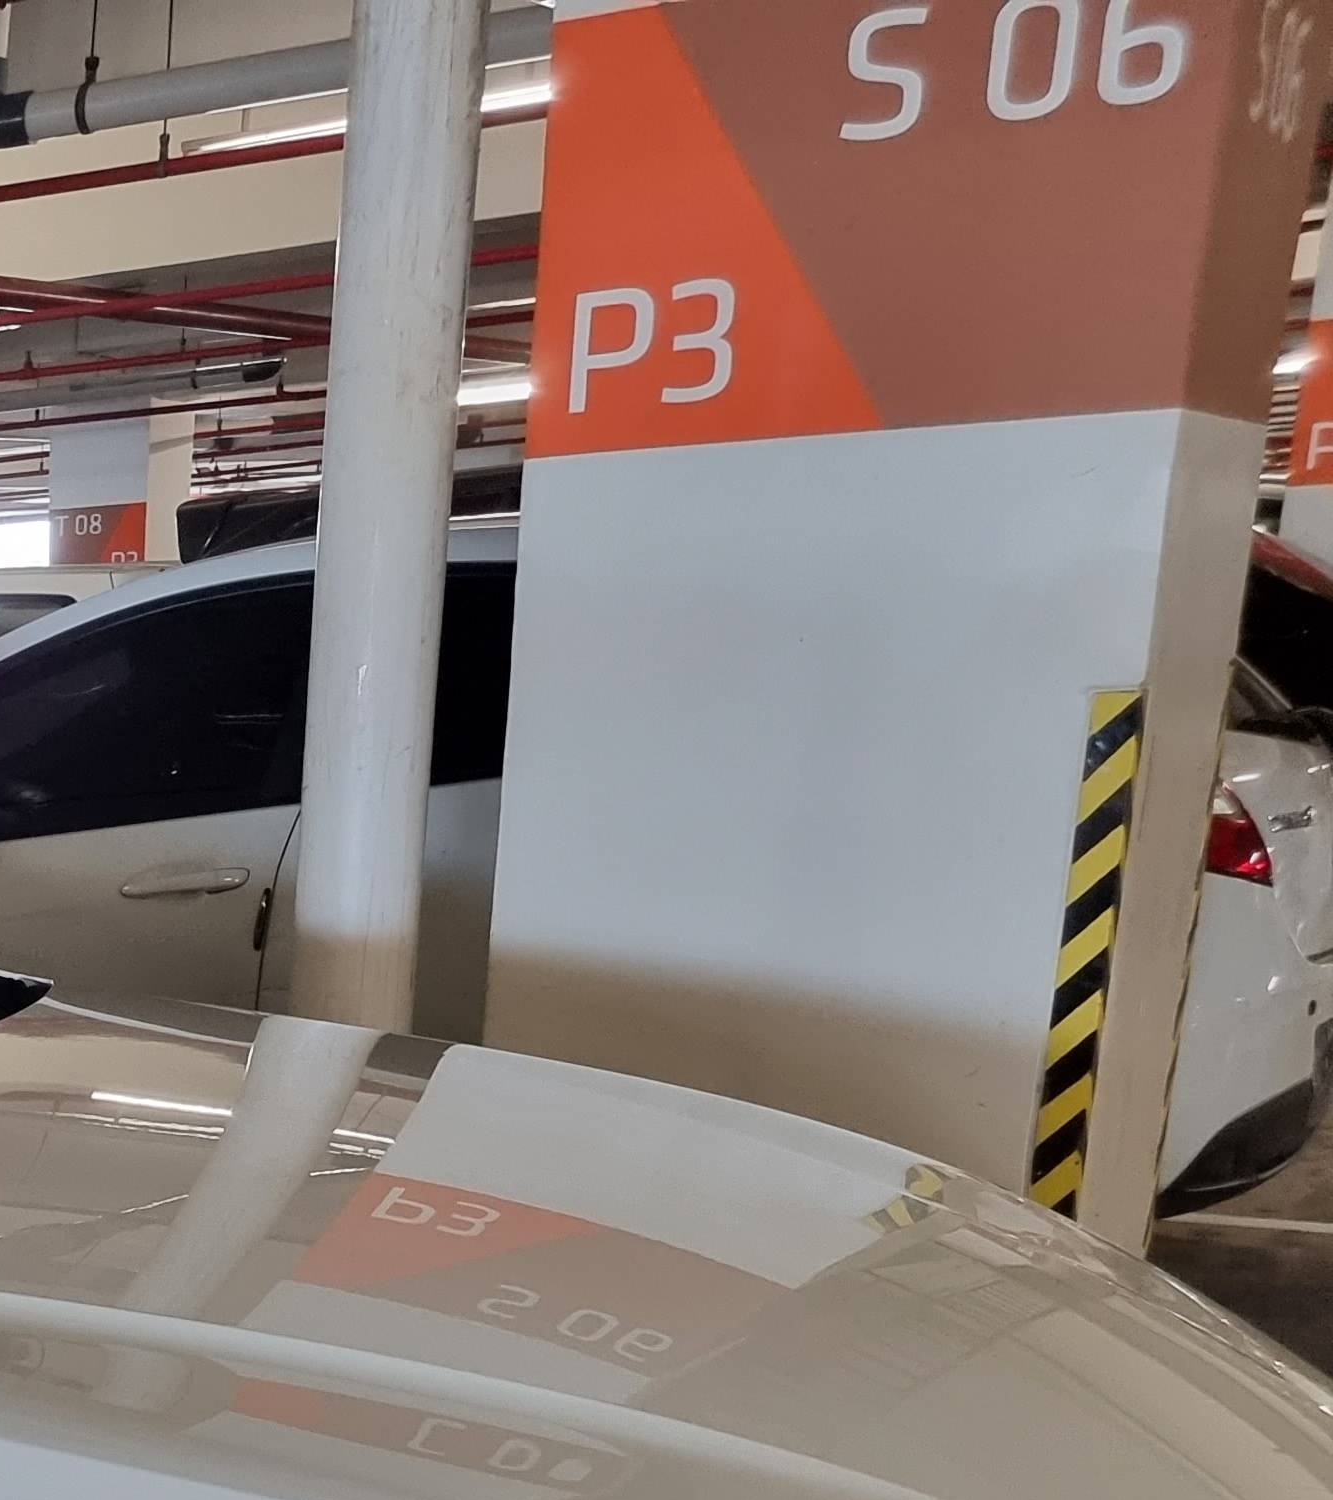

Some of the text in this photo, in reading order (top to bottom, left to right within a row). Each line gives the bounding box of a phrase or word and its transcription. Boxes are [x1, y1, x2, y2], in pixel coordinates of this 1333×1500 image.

[838, 7, 930, 142] S
[985, 0, 1185, 122] 06
[567, 277, 739, 415] P3
[54, 513, 102, 537] T 08
